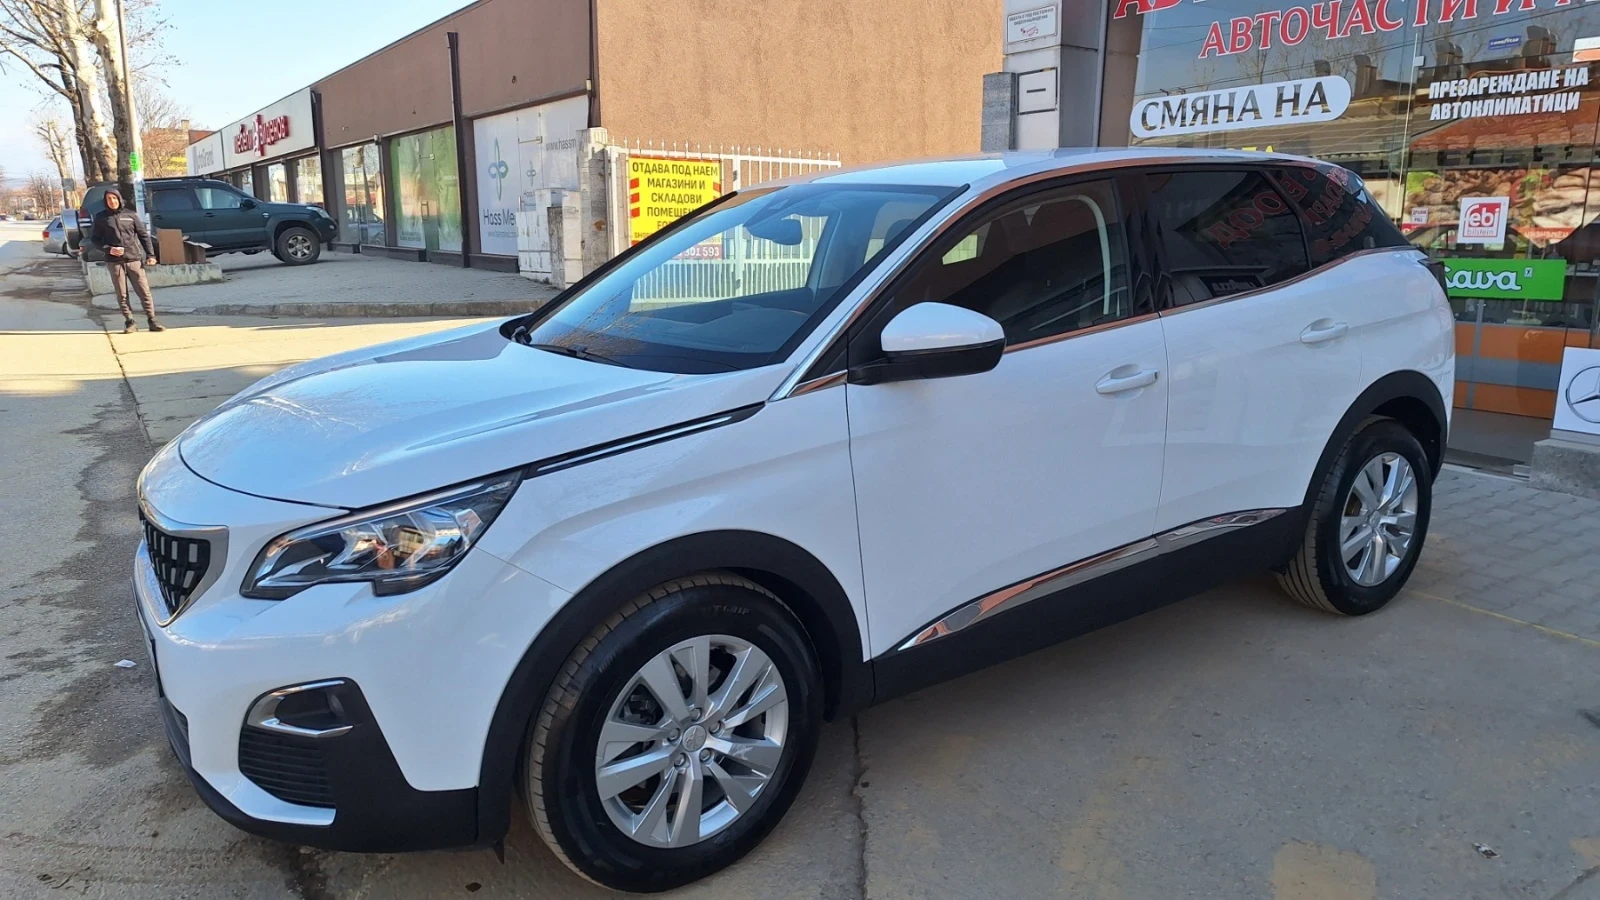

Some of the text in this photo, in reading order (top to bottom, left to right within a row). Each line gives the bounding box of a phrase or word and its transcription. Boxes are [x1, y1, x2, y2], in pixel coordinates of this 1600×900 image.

[1198, 0, 1477, 59] АВТОЧАСТИ
[1429, 67, 1589, 99] ПРЕЗАРЕЖДАНЕ НА
[1141, 81, 1332, 131] СМЯНА НА
[1430, 91, 1581, 121] АВТОКЛИМАТИЦИ
[632, 162, 718, 176] ОТДАВА ПОД НАЕМ
[647, 177, 706, 190] МАГАЗИНИ И
[651, 192, 702, 205] СКЛАДОВИ
[483, 208, 502, 226] Hass
[1464, 204, 1500, 228] febi
[1466, 227, 1495, 236] bilstein
[702, 246, 720, 257] 593
